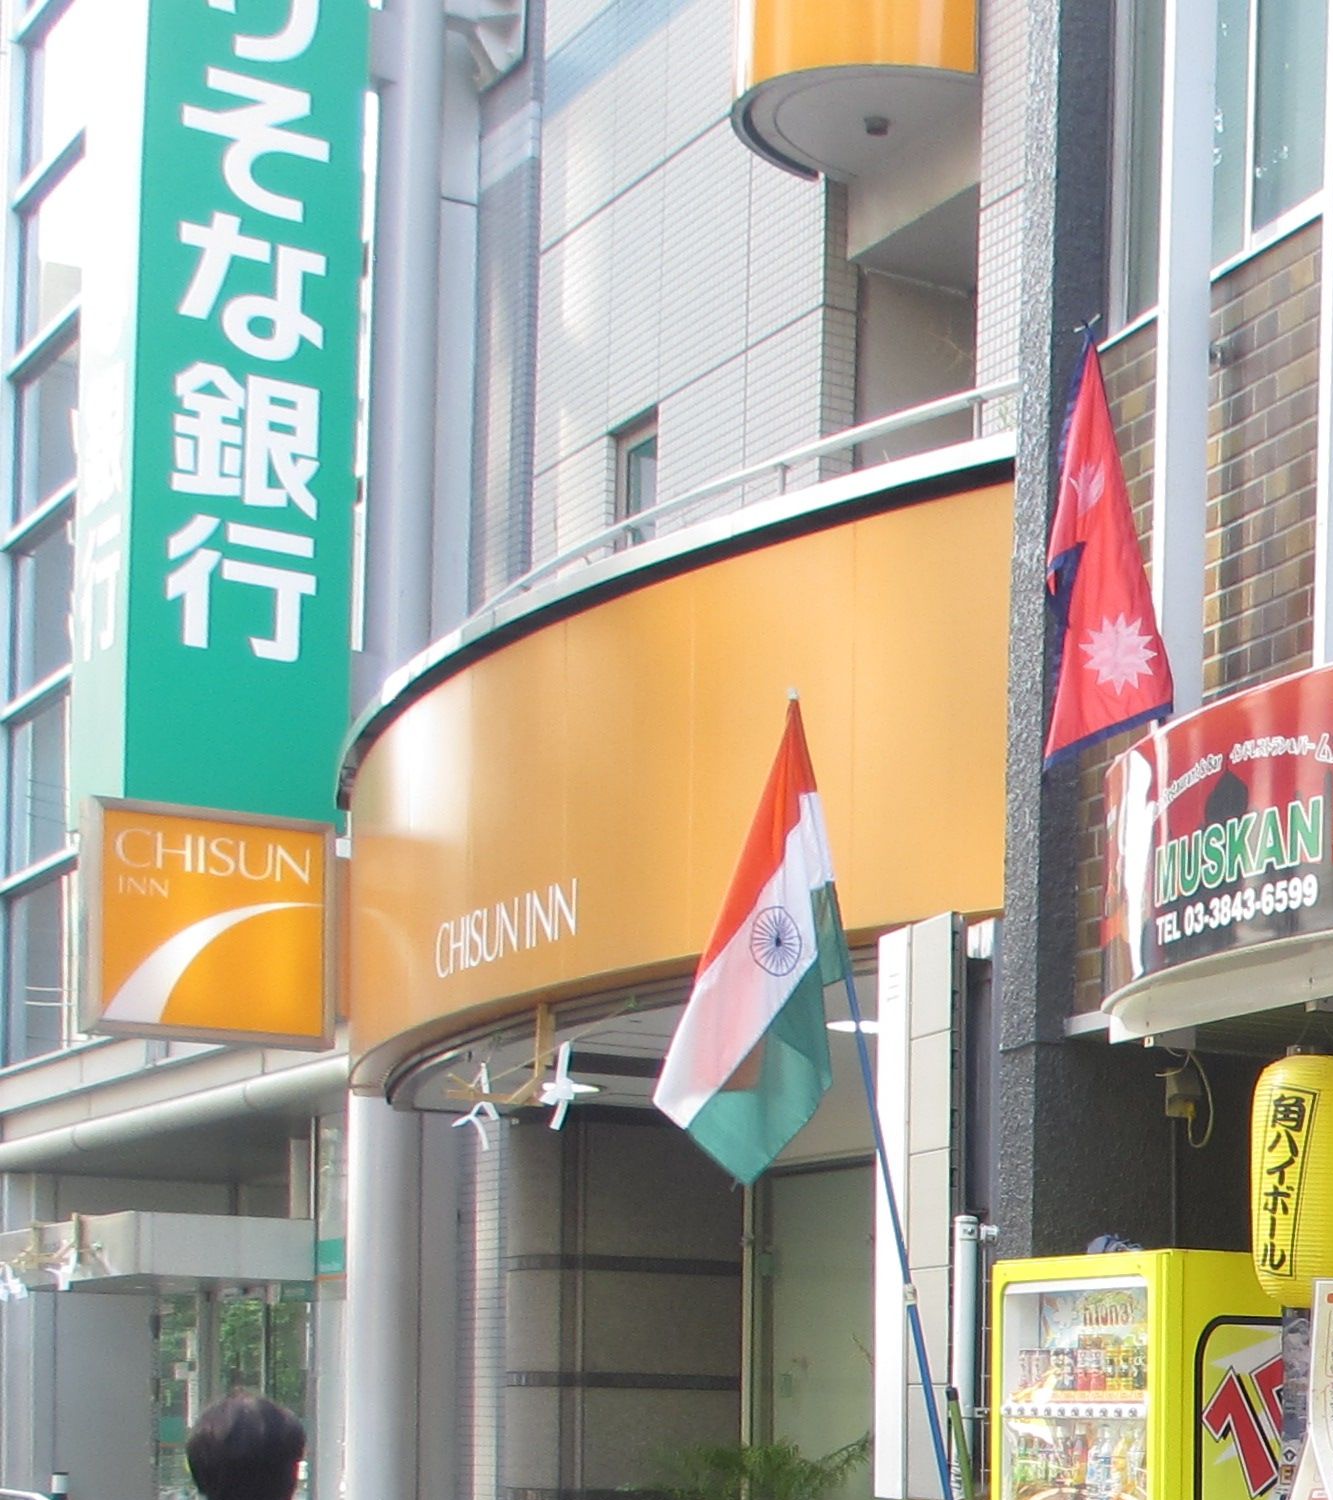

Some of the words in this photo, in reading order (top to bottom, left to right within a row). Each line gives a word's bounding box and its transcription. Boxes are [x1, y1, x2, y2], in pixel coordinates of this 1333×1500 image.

[114, 827, 311, 885] CHISUN
[118, 876, 171, 899] INN
[1154, 795, 1323, 907] MUSKAN
[435, 901, 518, 980] CHISUN
[525, 878, 578, 950] INN
[1156, 911, 1181, 946] TEL
[1184, 873, 1319, 937] 03-3843-6599
[1260, 1094, 1307, 1270] 角ハイボール
